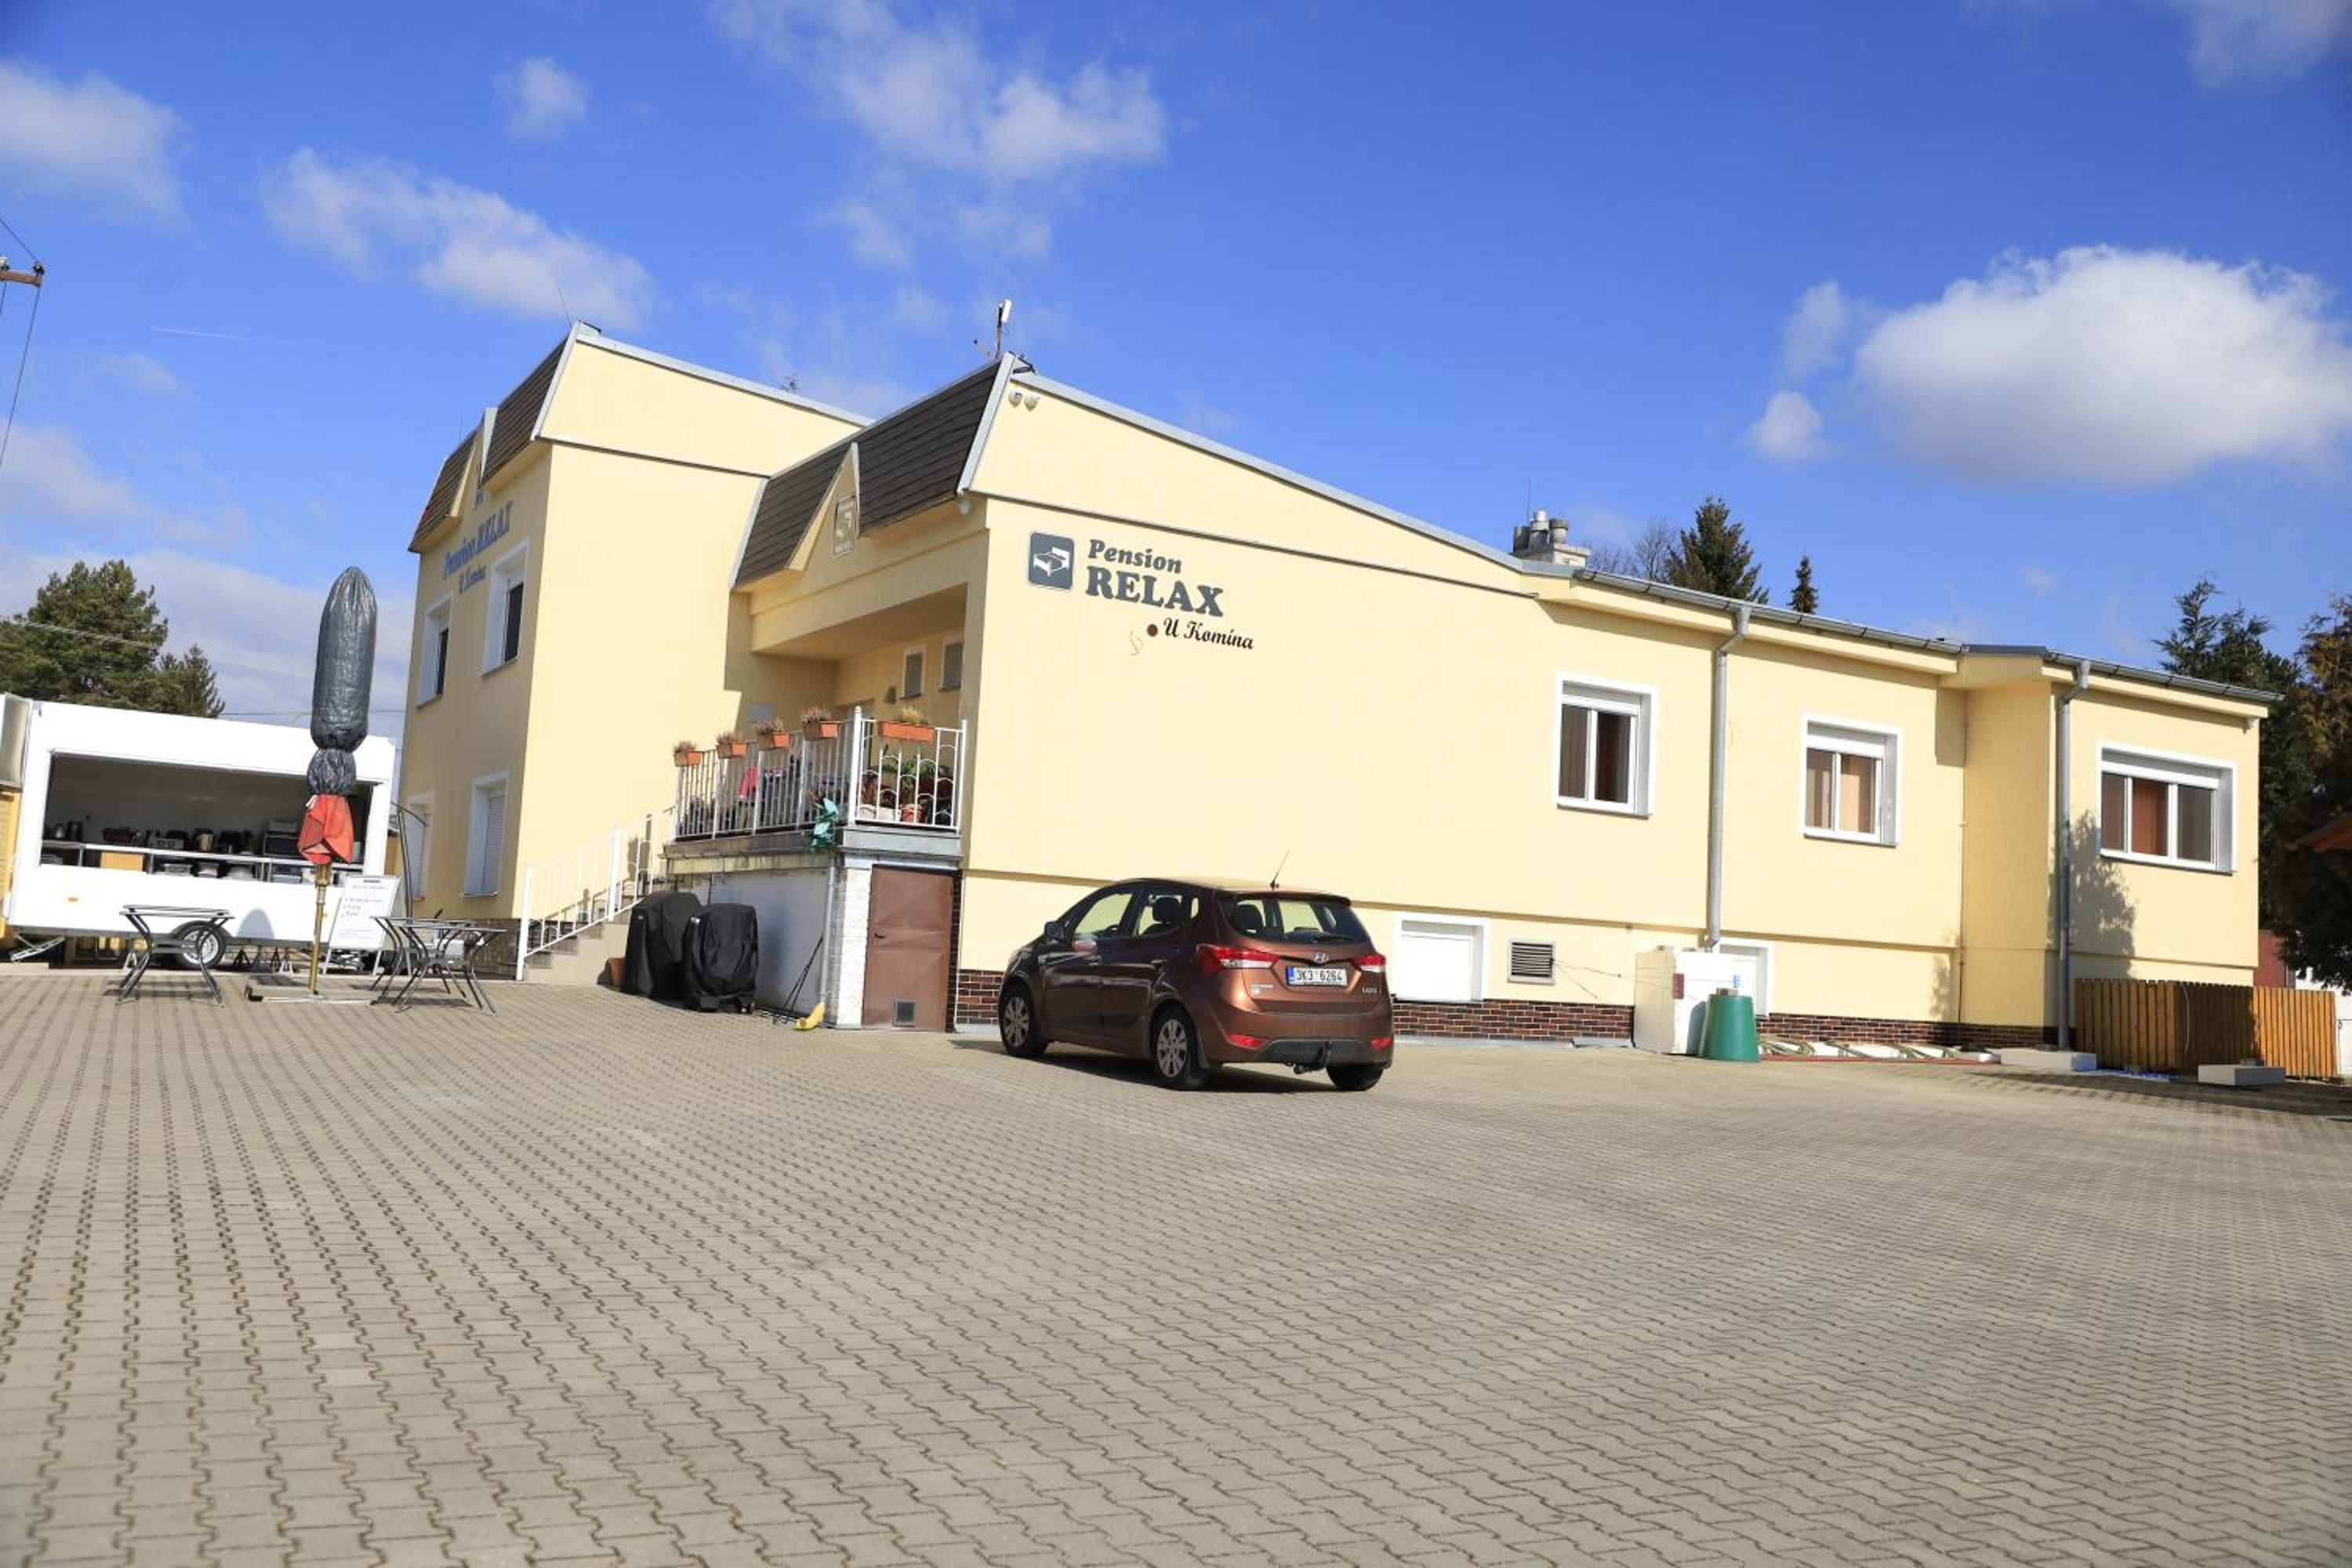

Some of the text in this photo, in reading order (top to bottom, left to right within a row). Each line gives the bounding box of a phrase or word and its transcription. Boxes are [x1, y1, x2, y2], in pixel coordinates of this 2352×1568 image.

[1088, 539, 1182, 574] Pension
[1086, 566, 1223, 617] RELAX
[1163, 617, 1180, 637] U
